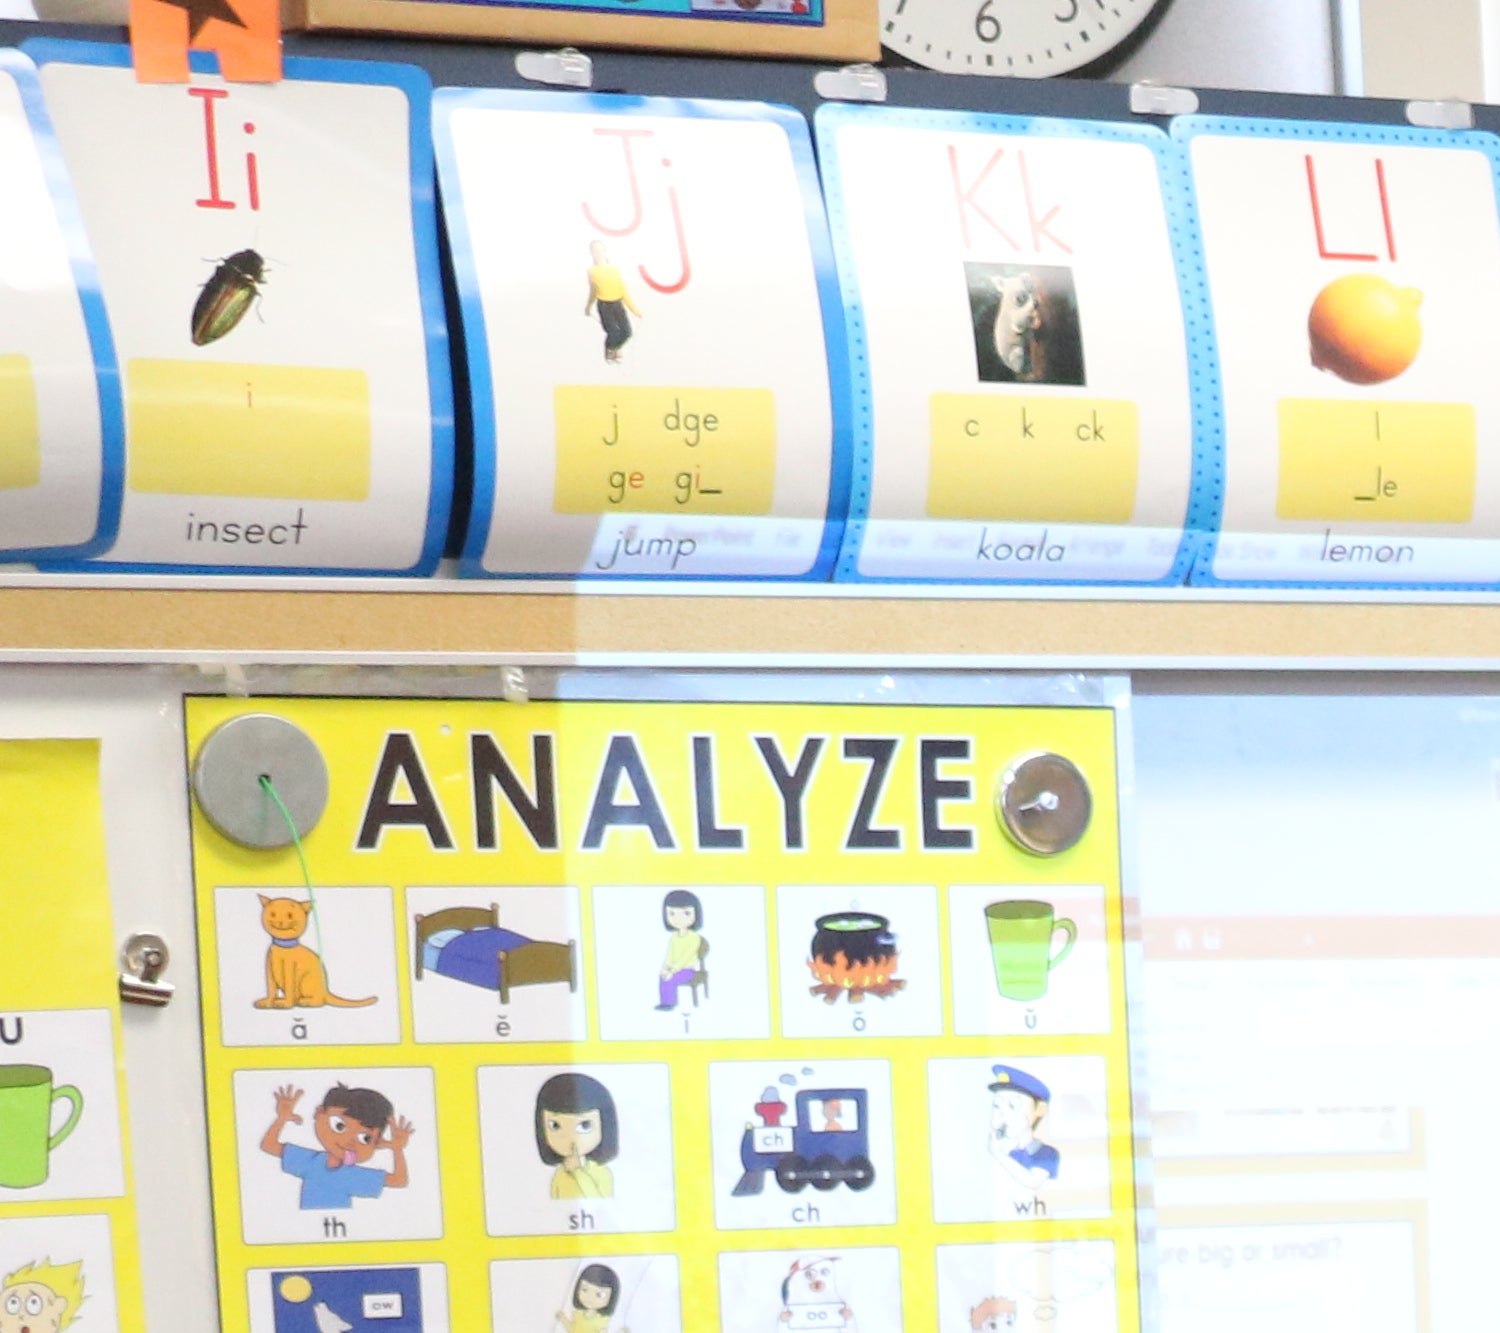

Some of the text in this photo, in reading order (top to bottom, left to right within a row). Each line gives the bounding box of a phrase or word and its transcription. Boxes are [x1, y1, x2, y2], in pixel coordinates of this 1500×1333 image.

[186, 510, 308, 547] insect
[975, 527, 1066, 564] koala
[595, 530, 697, 570] jump
[1319, 530, 1414, 565] lemon
[354, 731, 976, 851] ANALYZE
[1013, 1195, 1047, 1218] wh
